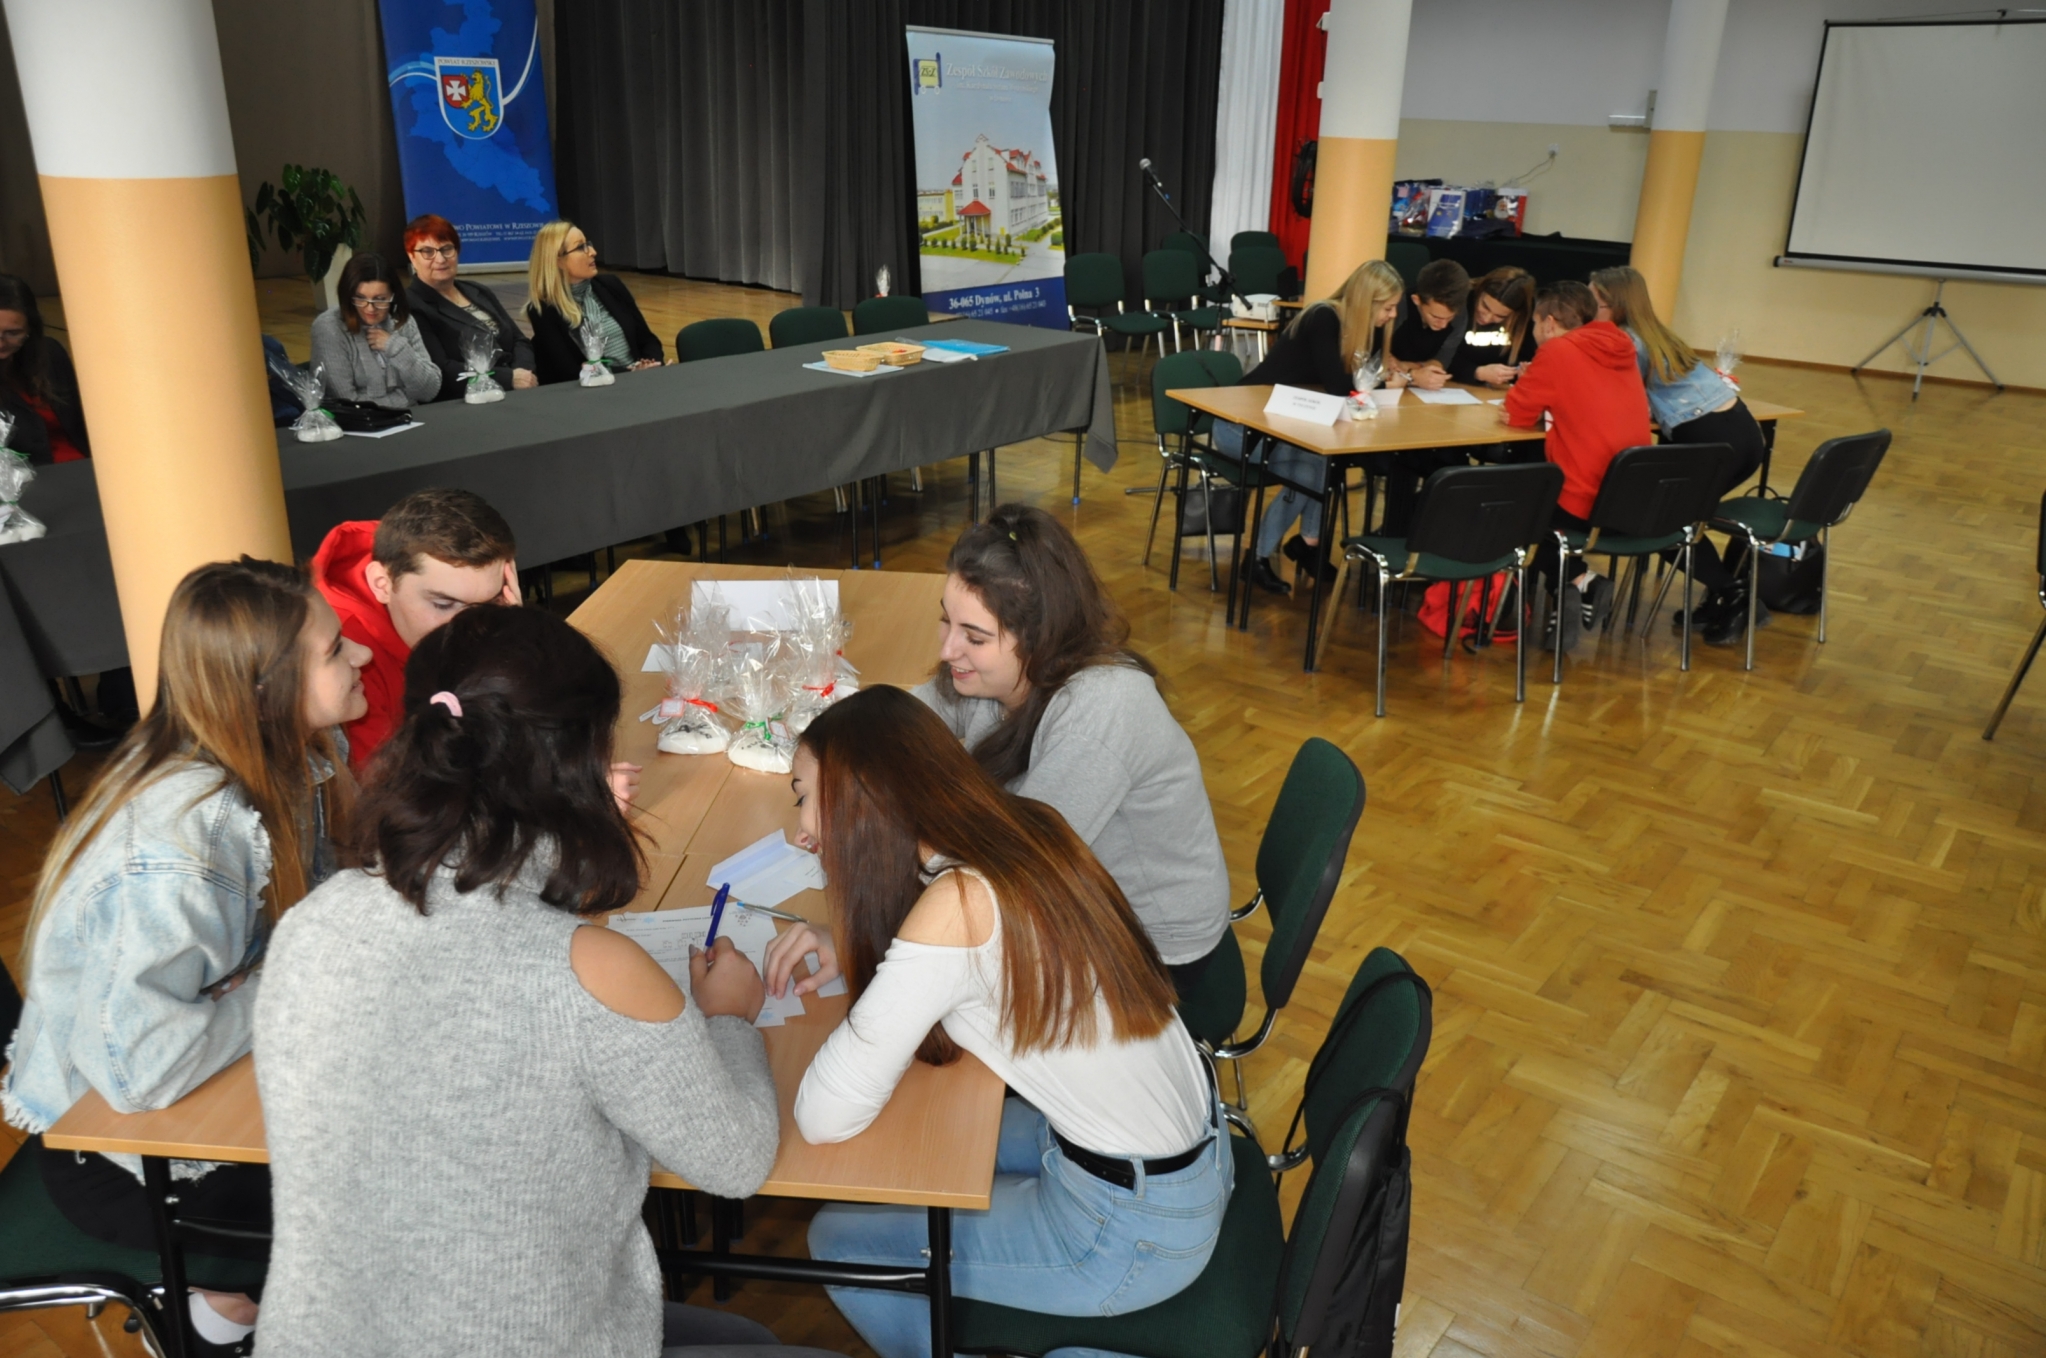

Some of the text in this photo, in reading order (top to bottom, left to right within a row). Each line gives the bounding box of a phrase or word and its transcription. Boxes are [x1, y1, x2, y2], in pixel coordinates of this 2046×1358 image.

[946, 62, 1048, 85] Zespół Szkół Zawodowych
[948, 295, 974, 310] 36-065
[974, 292, 1003, 308] Dynów,
[1034, 286, 1040, 298] 3
